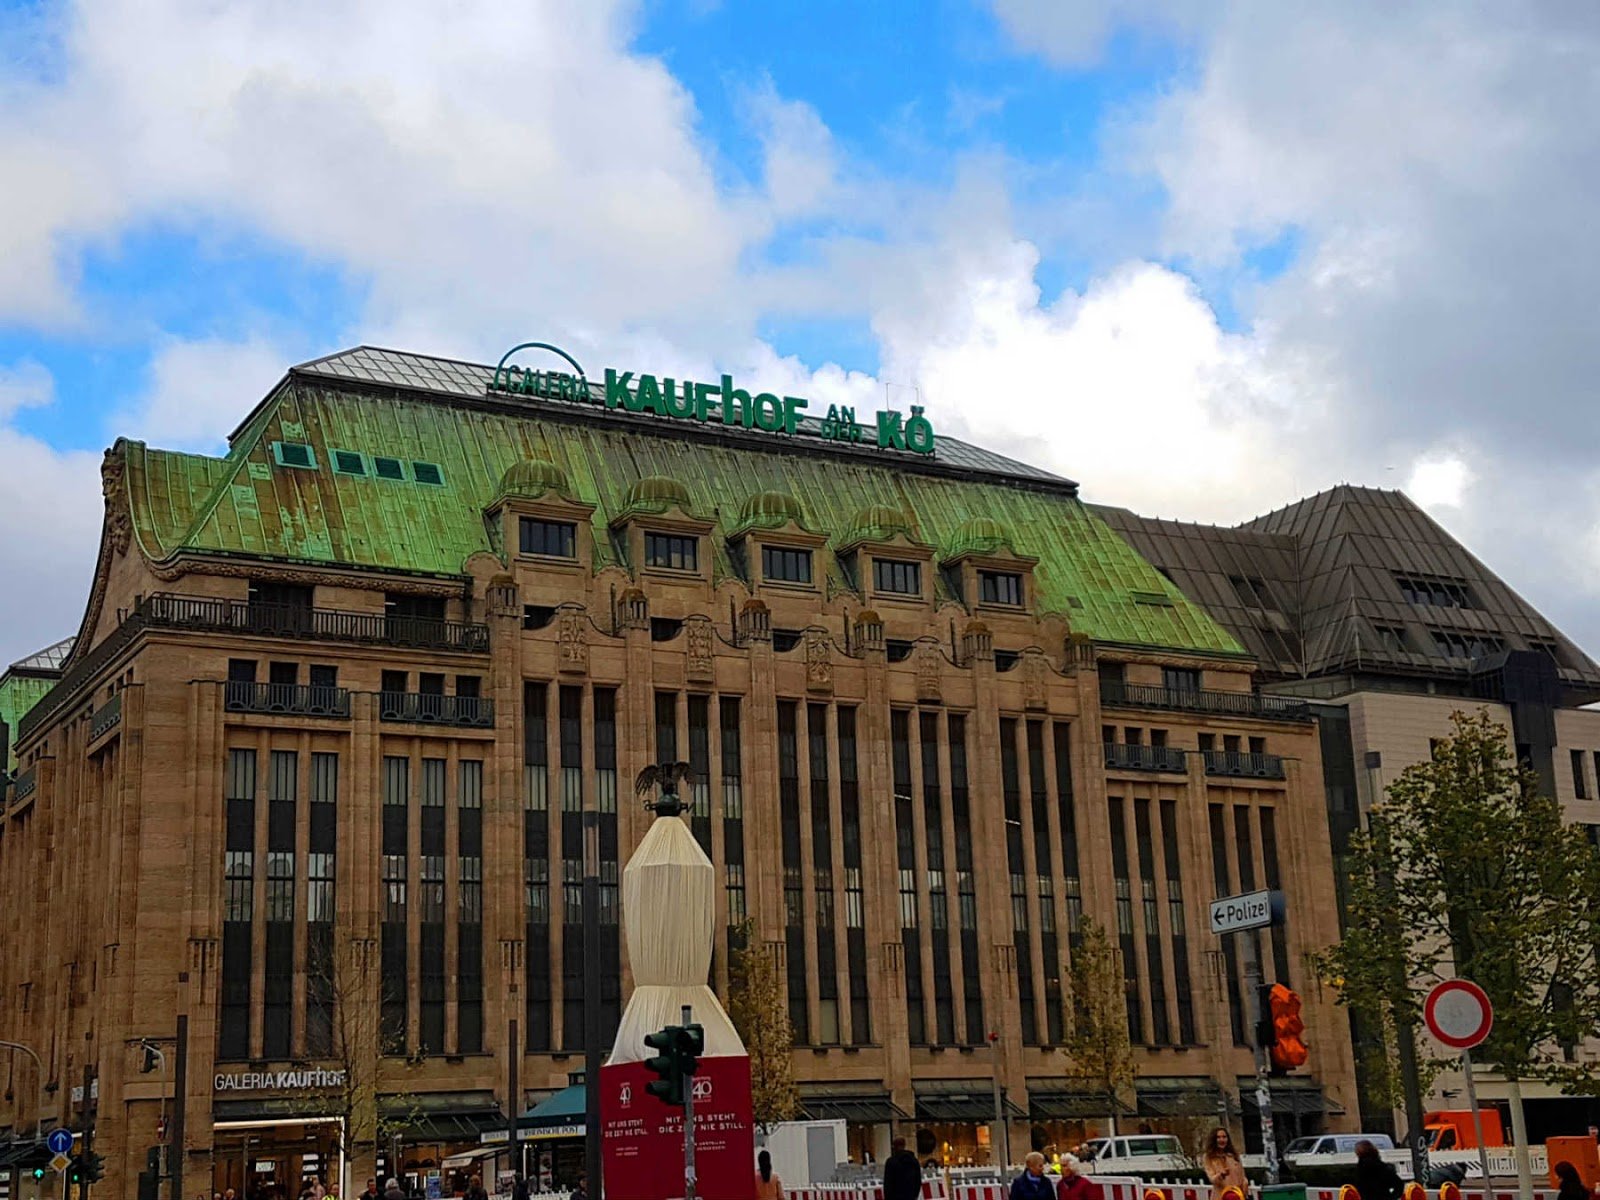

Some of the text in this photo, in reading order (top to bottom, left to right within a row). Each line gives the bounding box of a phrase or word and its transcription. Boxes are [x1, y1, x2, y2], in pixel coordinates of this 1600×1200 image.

[506, 364, 592, 403] GALERIA
[827, 403, 855, 424] AN
[821, 420, 863, 443] DER
[876, 405, 934, 453] KÖ
[1227, 896, 1268, 923] Polizei
[214, 1073, 275, 1090] GALERIA
[691, 1080, 713, 1099] 40
[707, 1112, 736, 1121] STEHT
[658, 1125, 675, 1134] DIE
